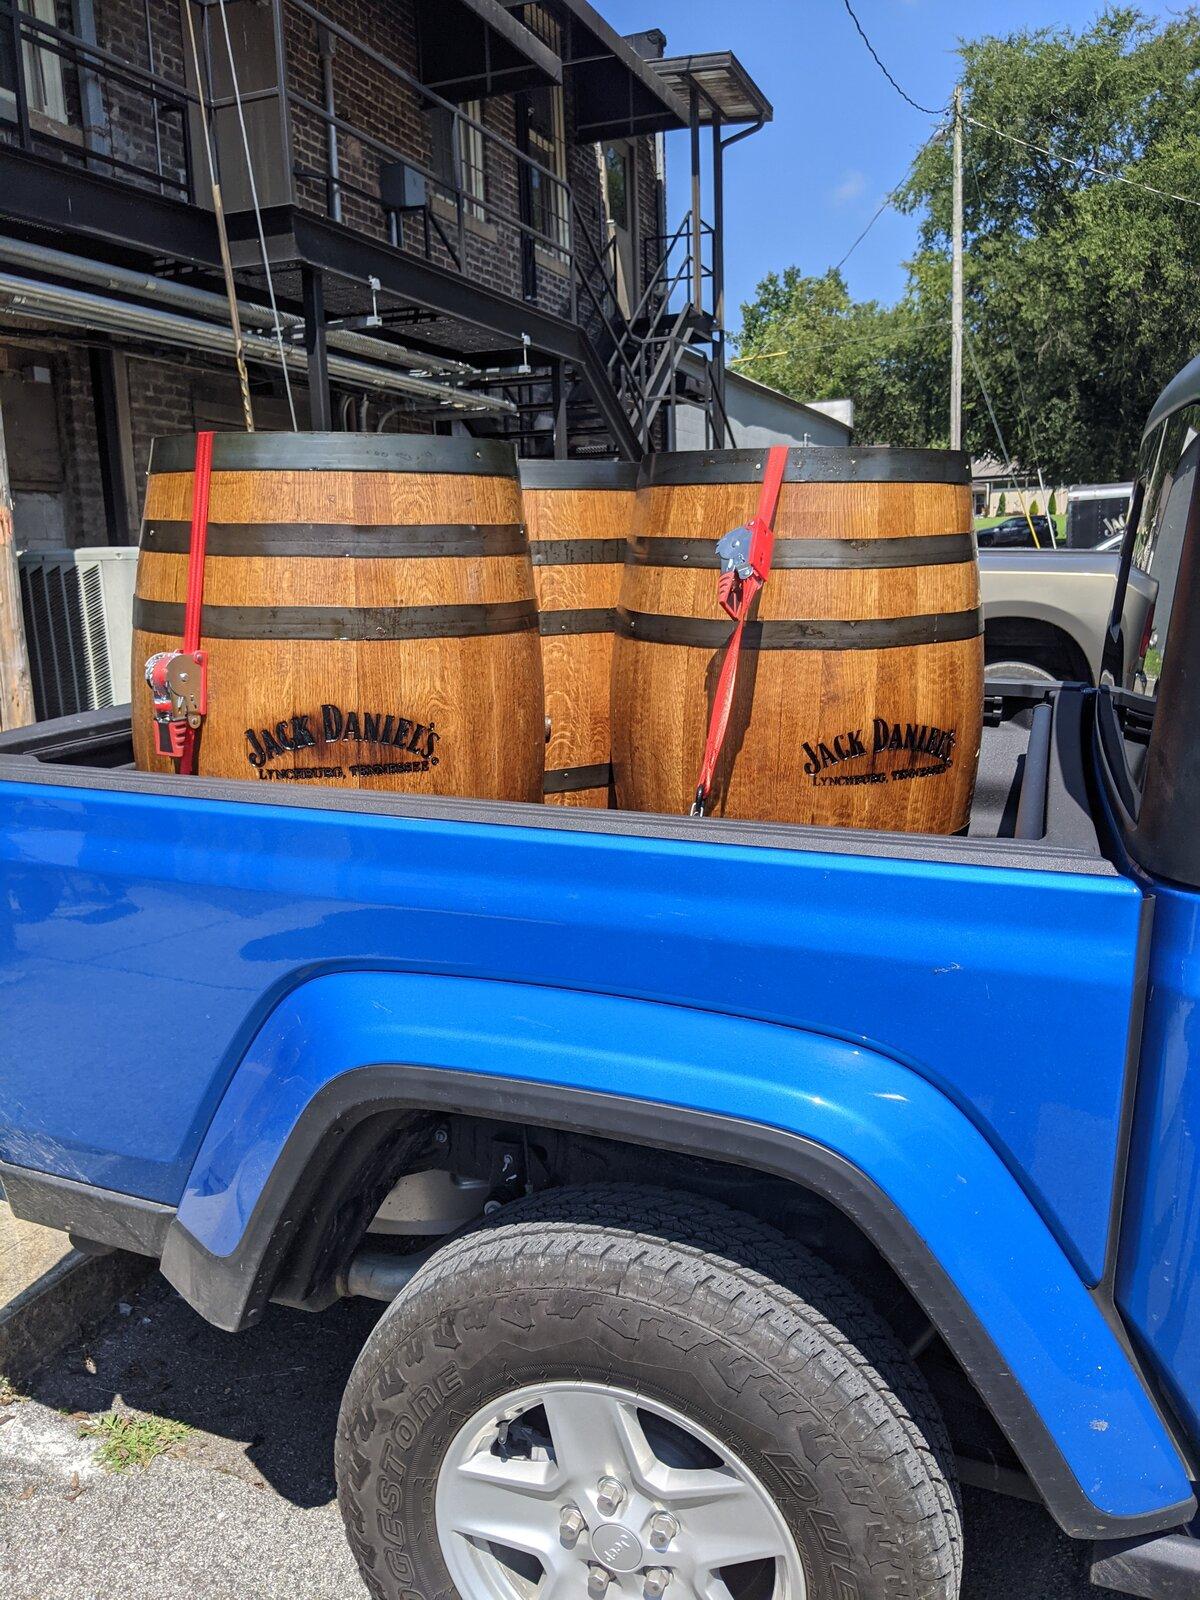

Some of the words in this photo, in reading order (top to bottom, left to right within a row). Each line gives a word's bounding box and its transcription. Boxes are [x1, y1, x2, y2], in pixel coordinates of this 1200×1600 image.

[244, 715, 316, 768] JACK
[320, 704, 441, 760] DANIEL'S
[801, 729, 867, 776] JACK
[376, 1360, 464, 1600] GESTONE
